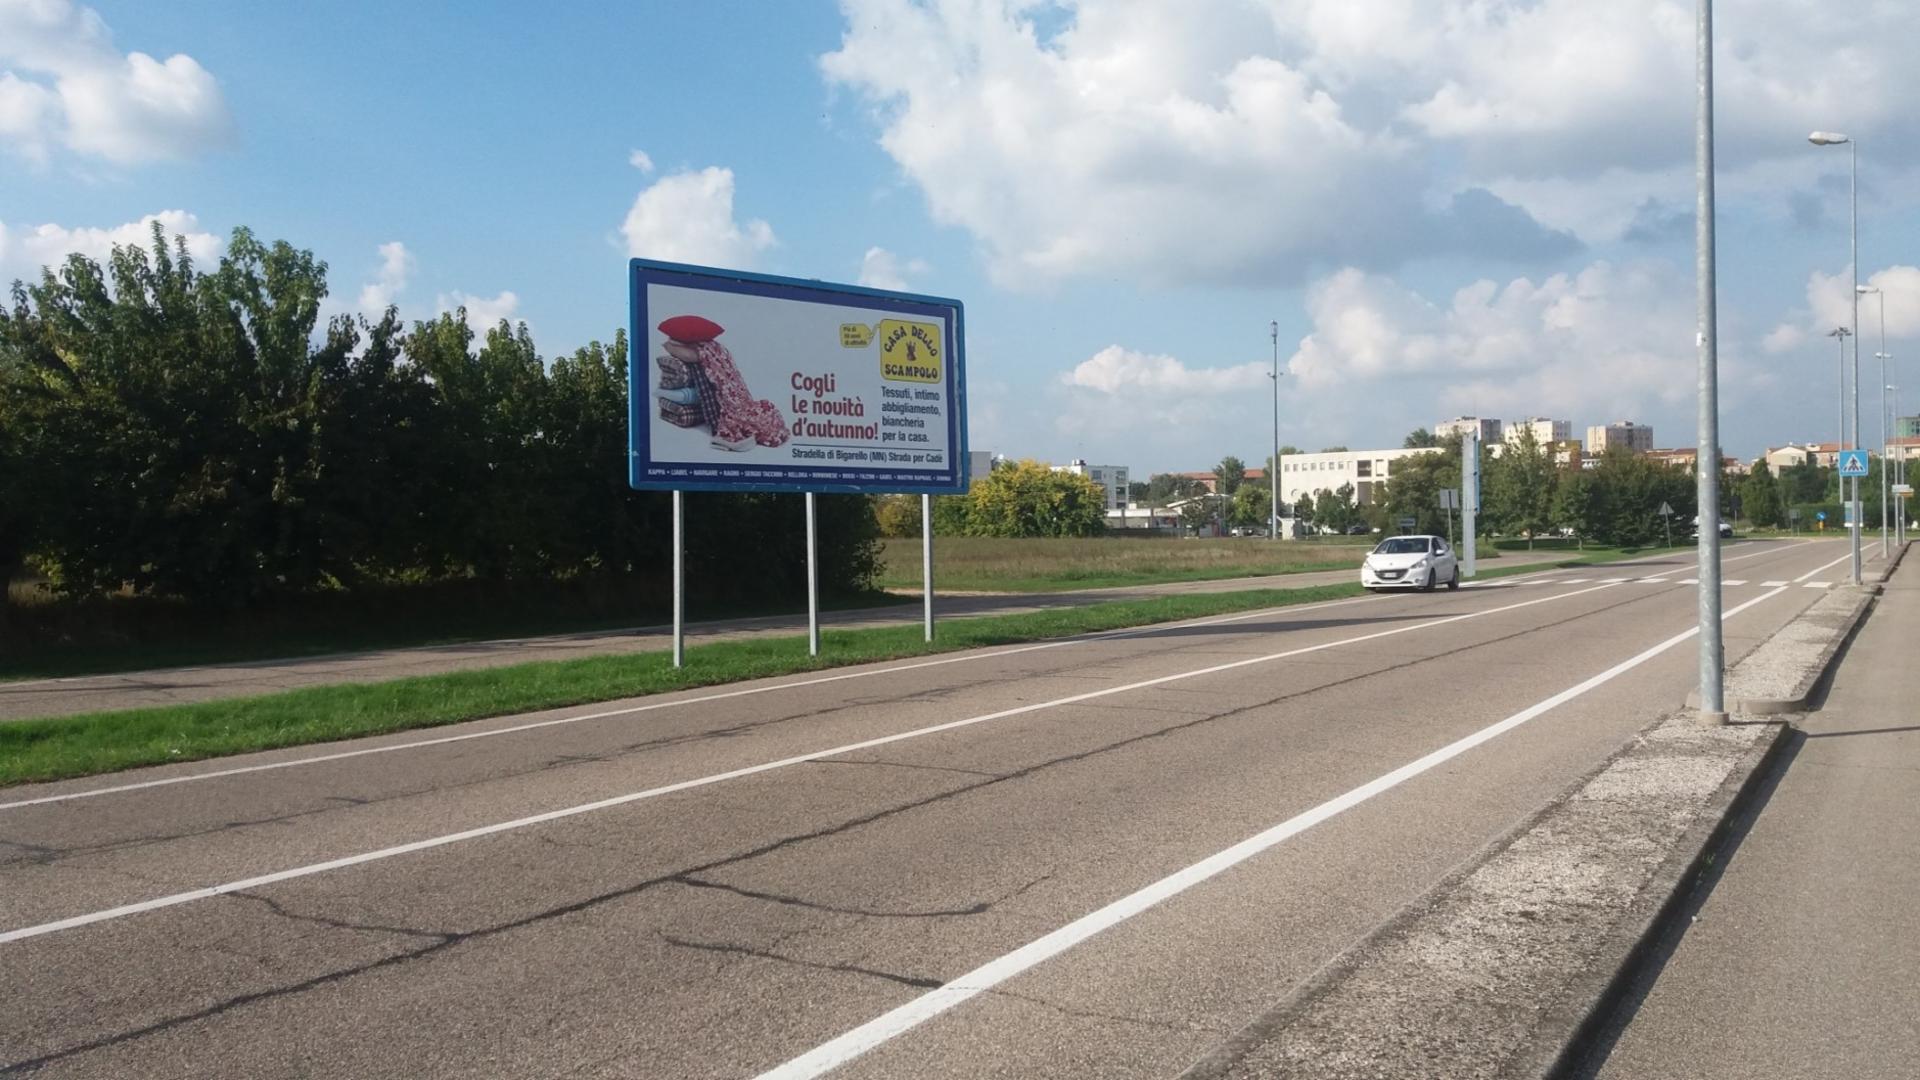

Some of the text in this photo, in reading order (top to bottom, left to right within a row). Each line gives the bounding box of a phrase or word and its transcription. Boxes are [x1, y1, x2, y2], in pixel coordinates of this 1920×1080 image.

[884, 325, 938, 357] CASA DELLO
[885, 364, 938, 379] SCAMPOLO
[791, 372, 835, 398] Cogli
[881, 386, 940, 401] Tessuti, intimo
[792, 394, 864, 417] le novità
[881, 401, 941, 416] abbigliamento,
[792, 417, 879, 440] d'autunno!
[882, 416, 925, 428] biancheria
[882, 431, 930, 443] per la casa.
[792, 448, 826, 459] Stradella
[827, 449, 834, 459] di
[836, 450, 868, 462] Bigarello
[869, 451, 887, 463] (MN)
[888, 452, 911, 462] Strada
[913, 455, 925, 464] per
